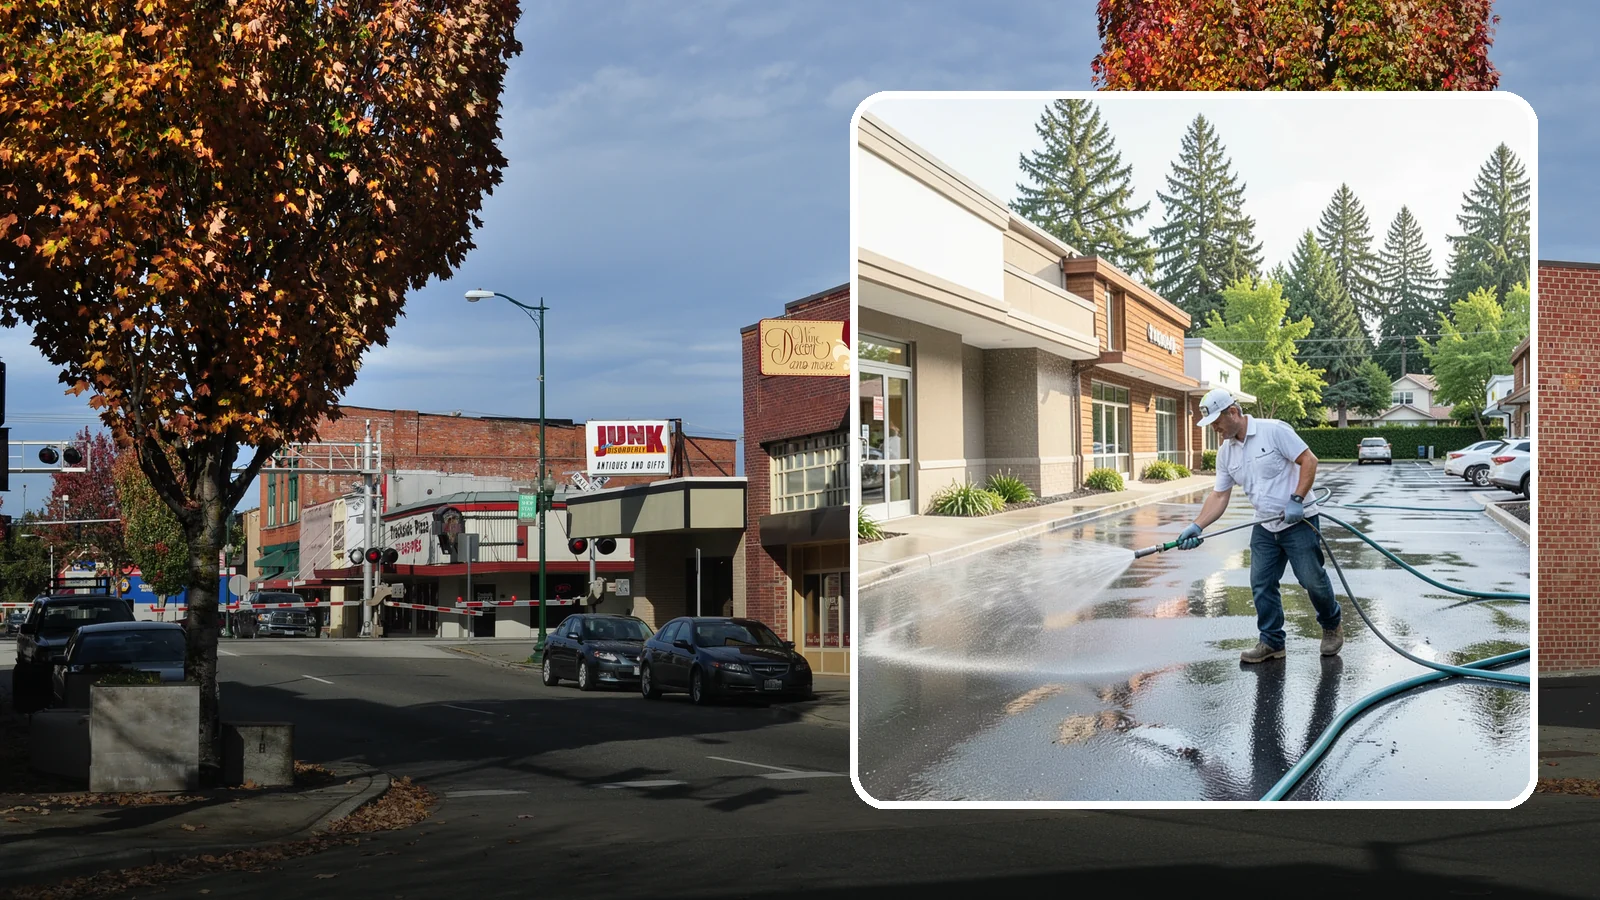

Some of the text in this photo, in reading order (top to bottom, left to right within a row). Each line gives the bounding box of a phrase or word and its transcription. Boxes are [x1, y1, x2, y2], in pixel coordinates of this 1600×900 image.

[596, 425, 665, 457] JUNK
[608, 446, 645, 454] DISORDERLY
[597, 460, 665, 470] ANTIQUES AND GIFTS
[414, 519, 429, 535] Pizza
